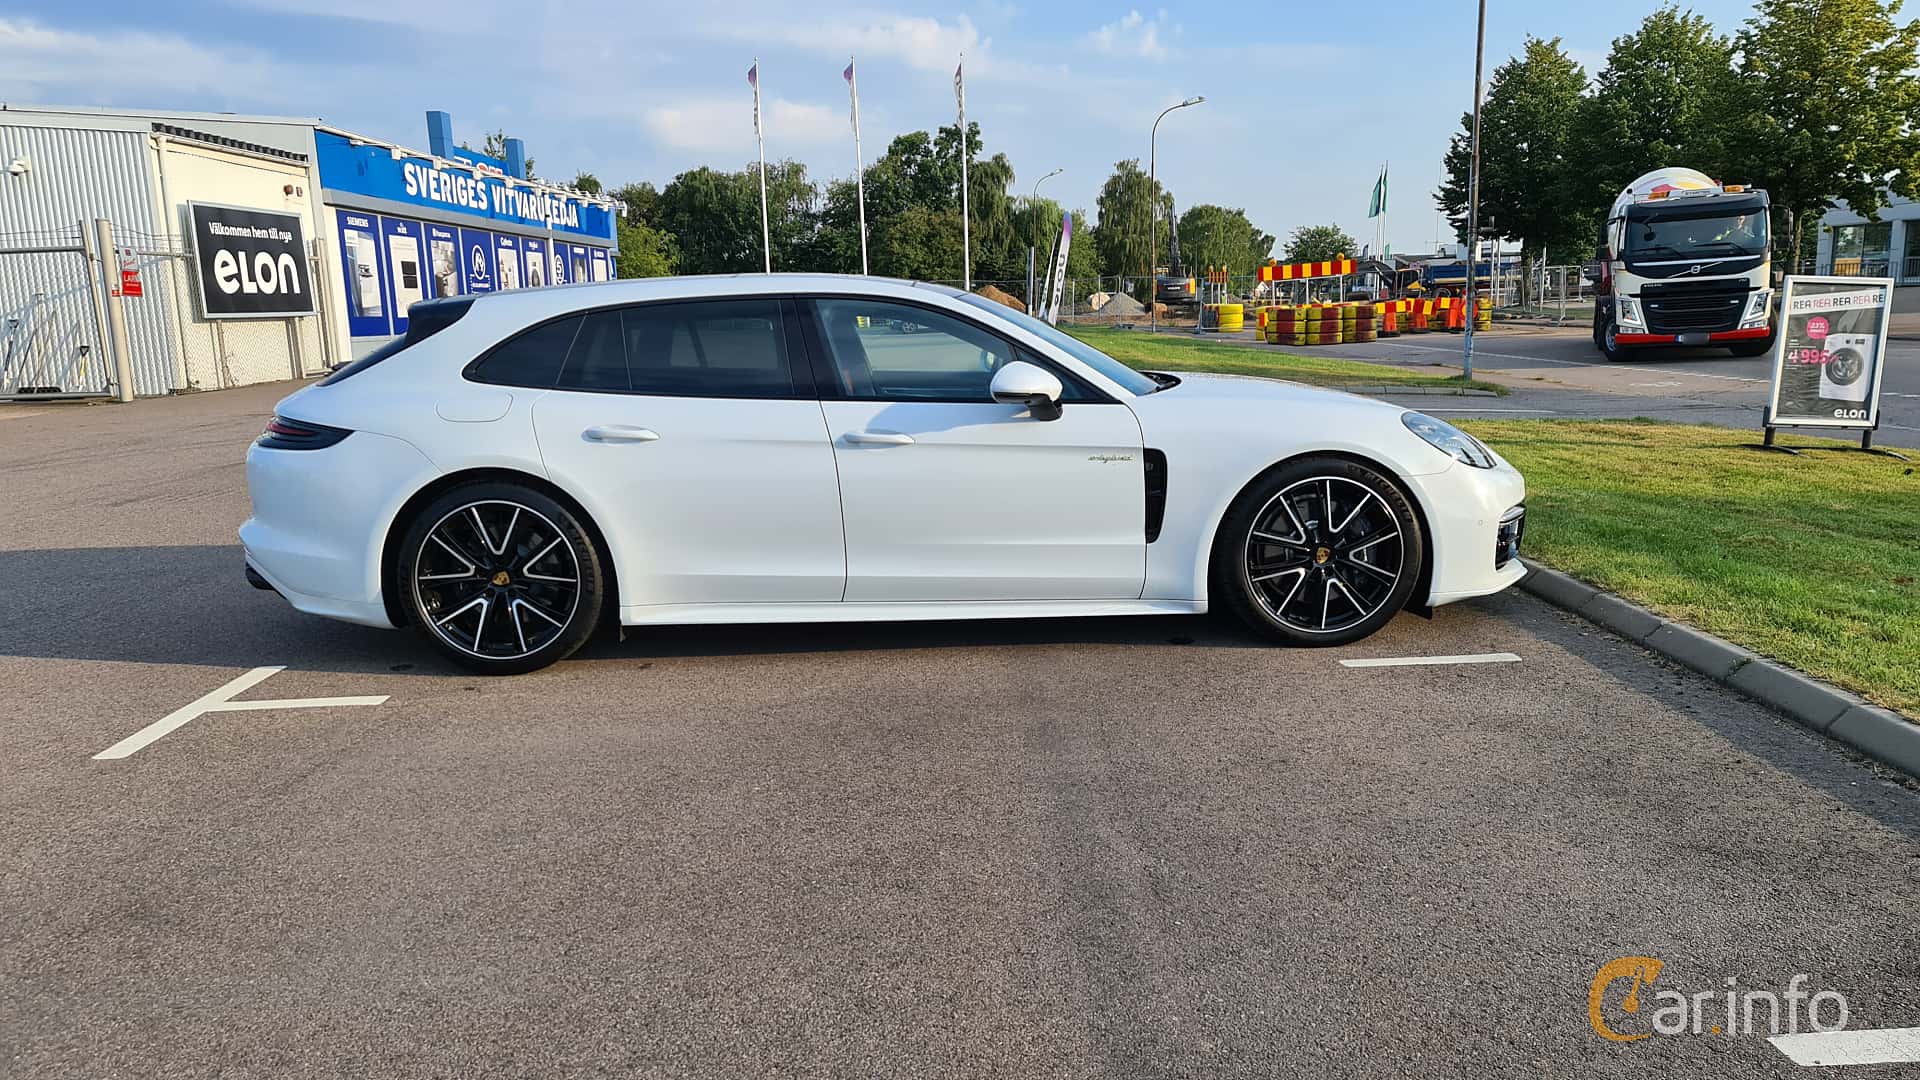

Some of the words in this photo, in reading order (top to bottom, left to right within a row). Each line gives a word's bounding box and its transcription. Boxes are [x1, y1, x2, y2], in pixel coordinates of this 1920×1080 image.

[404, 162, 488, 211] SVERIGES
[208, 222, 252, 238] Välkommen
[251, 226, 269, 239] hem
[269, 228, 279, 240] till
[279, 231, 293, 243] nya
[1793, 299, 1811, 310] REA
[1813, 298, 1831, 308] REA
[1833, 296, 1851, 307] REA
[1853, 295, 1871, 305] REA
[1872, 294, 1886, 304] RE
